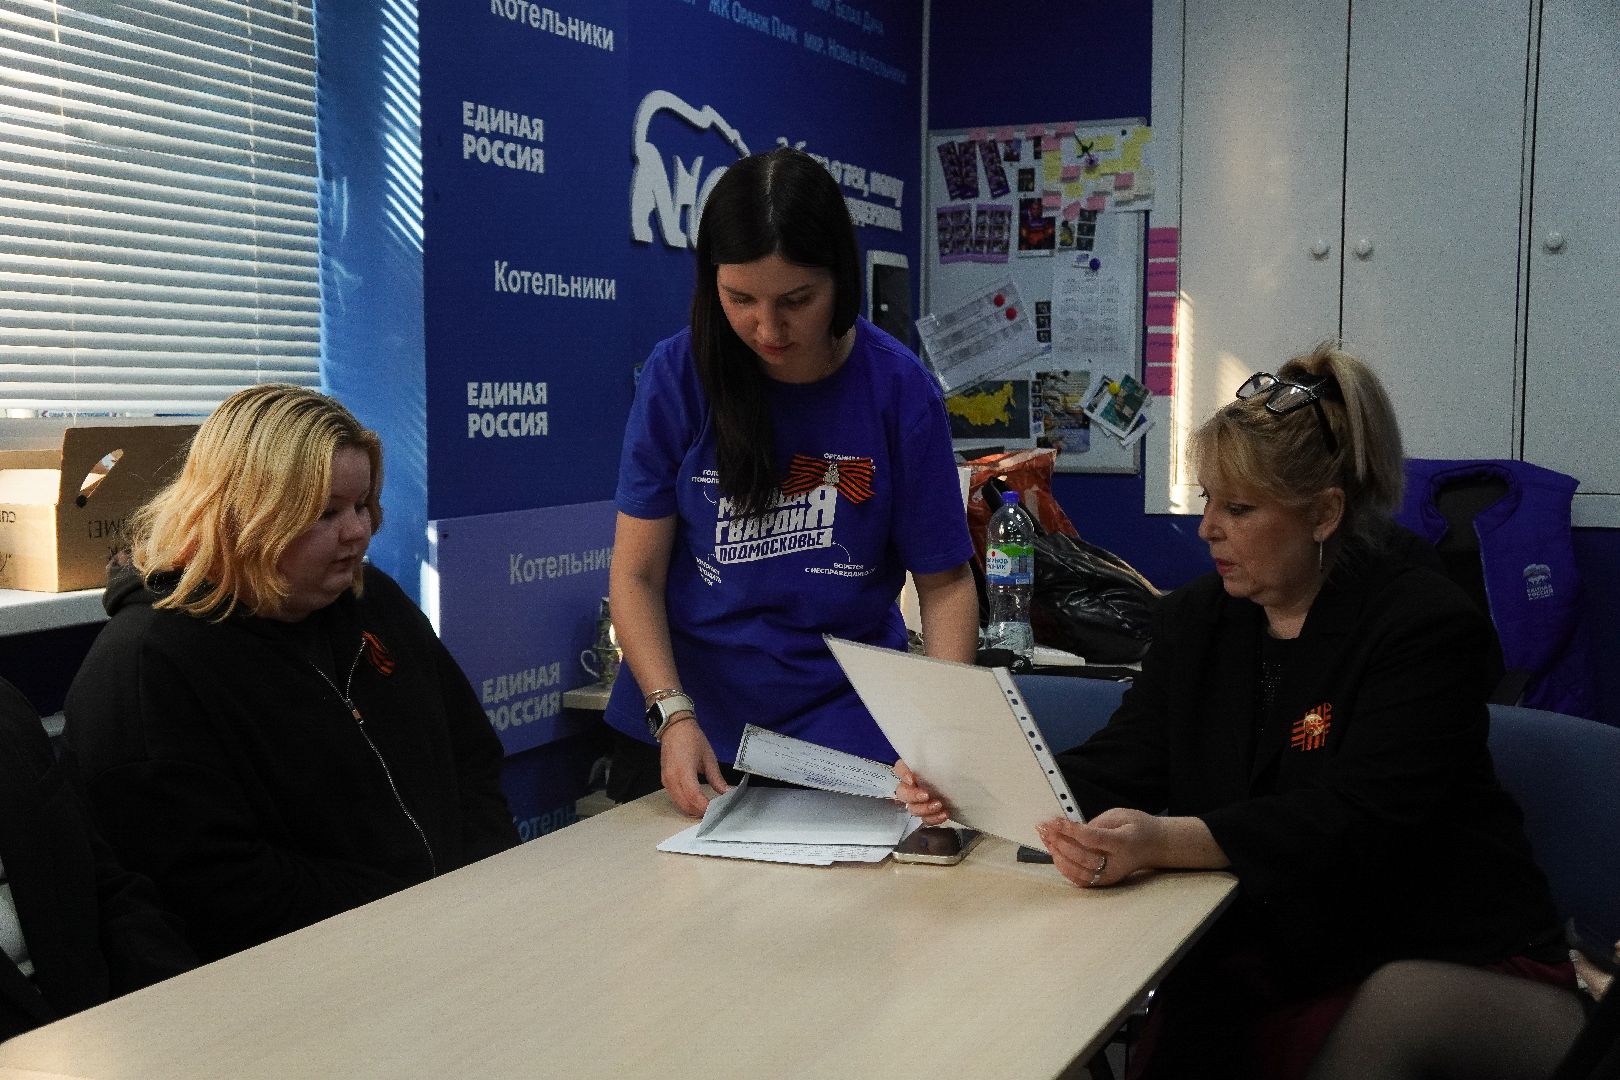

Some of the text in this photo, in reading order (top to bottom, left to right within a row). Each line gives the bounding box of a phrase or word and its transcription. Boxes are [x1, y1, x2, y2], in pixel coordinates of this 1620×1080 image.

[490, 0, 614, 52] Котельники
[462, 101, 544, 142] ЕДИНАЯ
[462, 132, 544, 174] РОССИЯ
[494, 260, 616, 301] Котельники
[467, 381, 548, 409] ЕДИНАЯ
[467, 411, 548, 439] РОССИЯ
[716, 484, 838, 544] ГВАРДИЯ
[720, 531, 825, 562] ПОДМОСКОВЬЕ
[481, 661, 560, 705] ЕДИНАЯ
